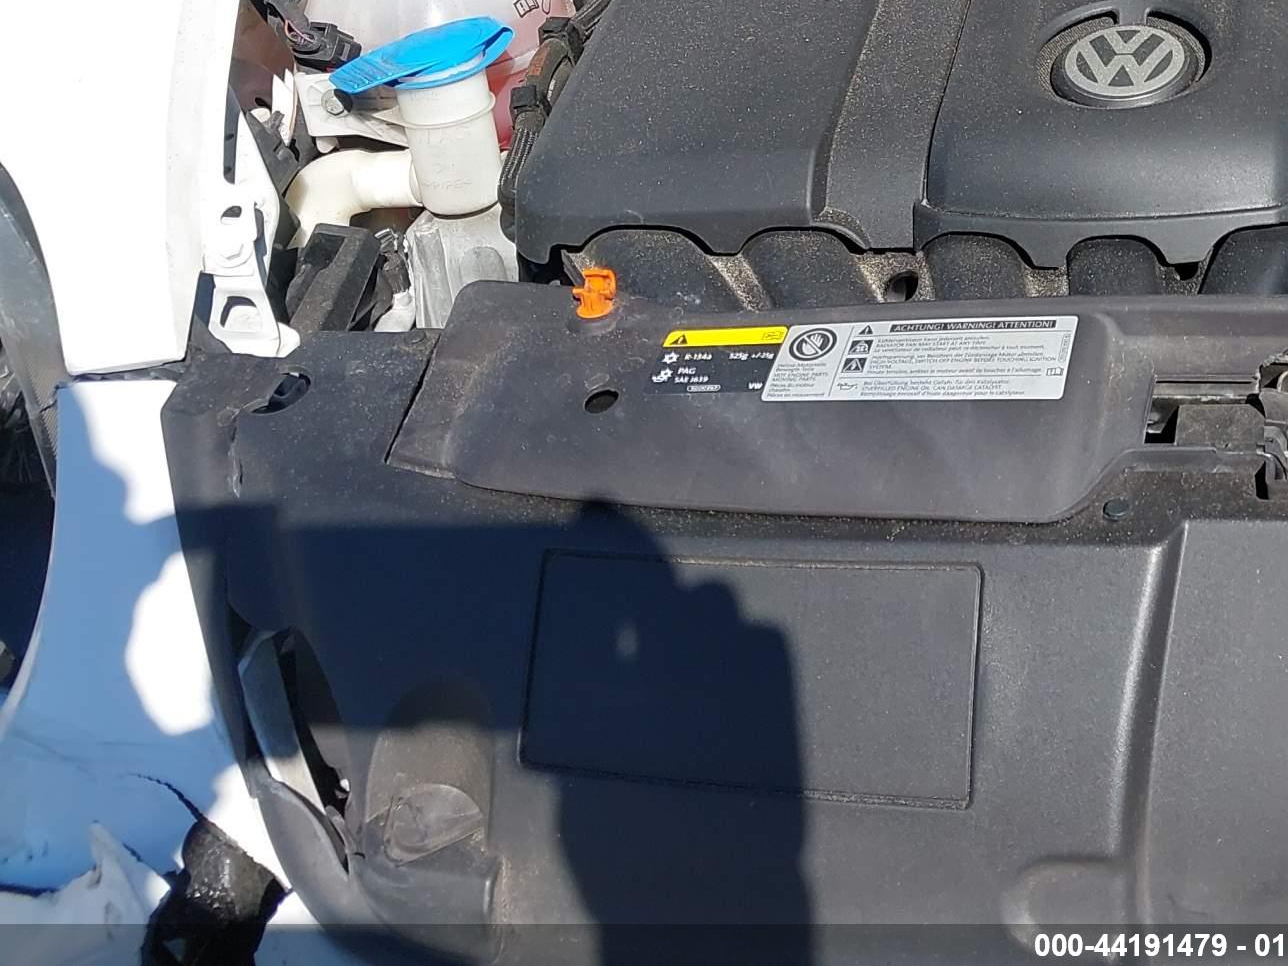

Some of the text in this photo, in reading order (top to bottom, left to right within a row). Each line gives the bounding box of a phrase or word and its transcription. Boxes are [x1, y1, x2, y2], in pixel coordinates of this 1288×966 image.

[894, 320, 1054, 332] ACHTUNG! WARNING! ATTENTION!
[677, 367, 697, 375] PAG
[748, 381, 763, 390] VW
